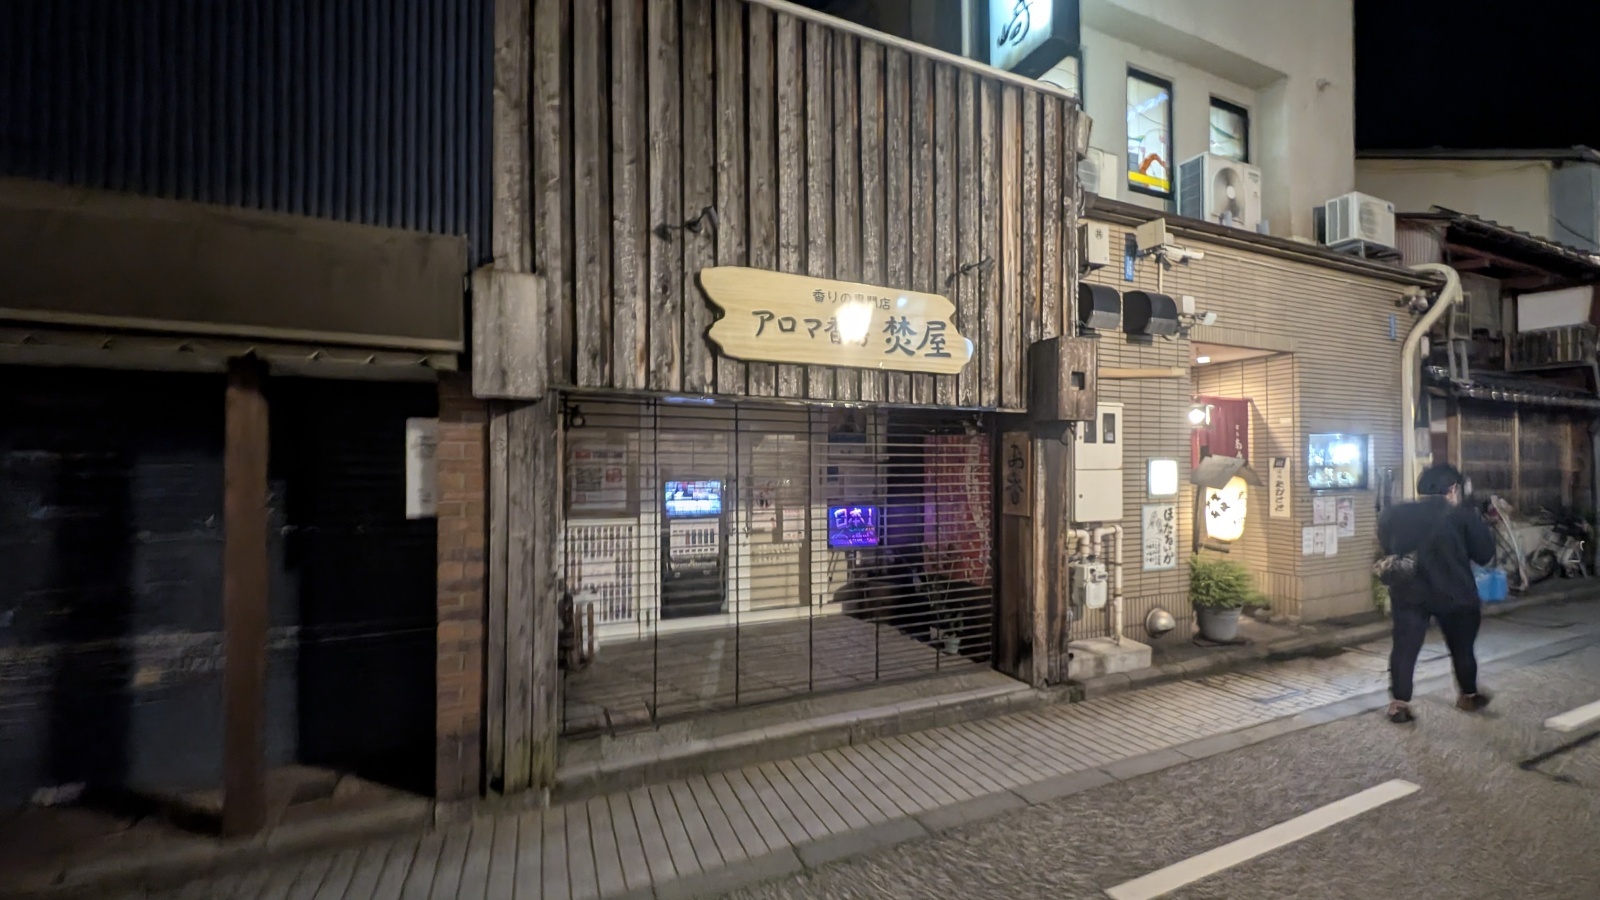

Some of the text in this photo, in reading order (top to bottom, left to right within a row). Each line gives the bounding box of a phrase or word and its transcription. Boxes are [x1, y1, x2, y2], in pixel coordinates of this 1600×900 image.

[752, 309, 952, 358] アロマ香 焚屋
